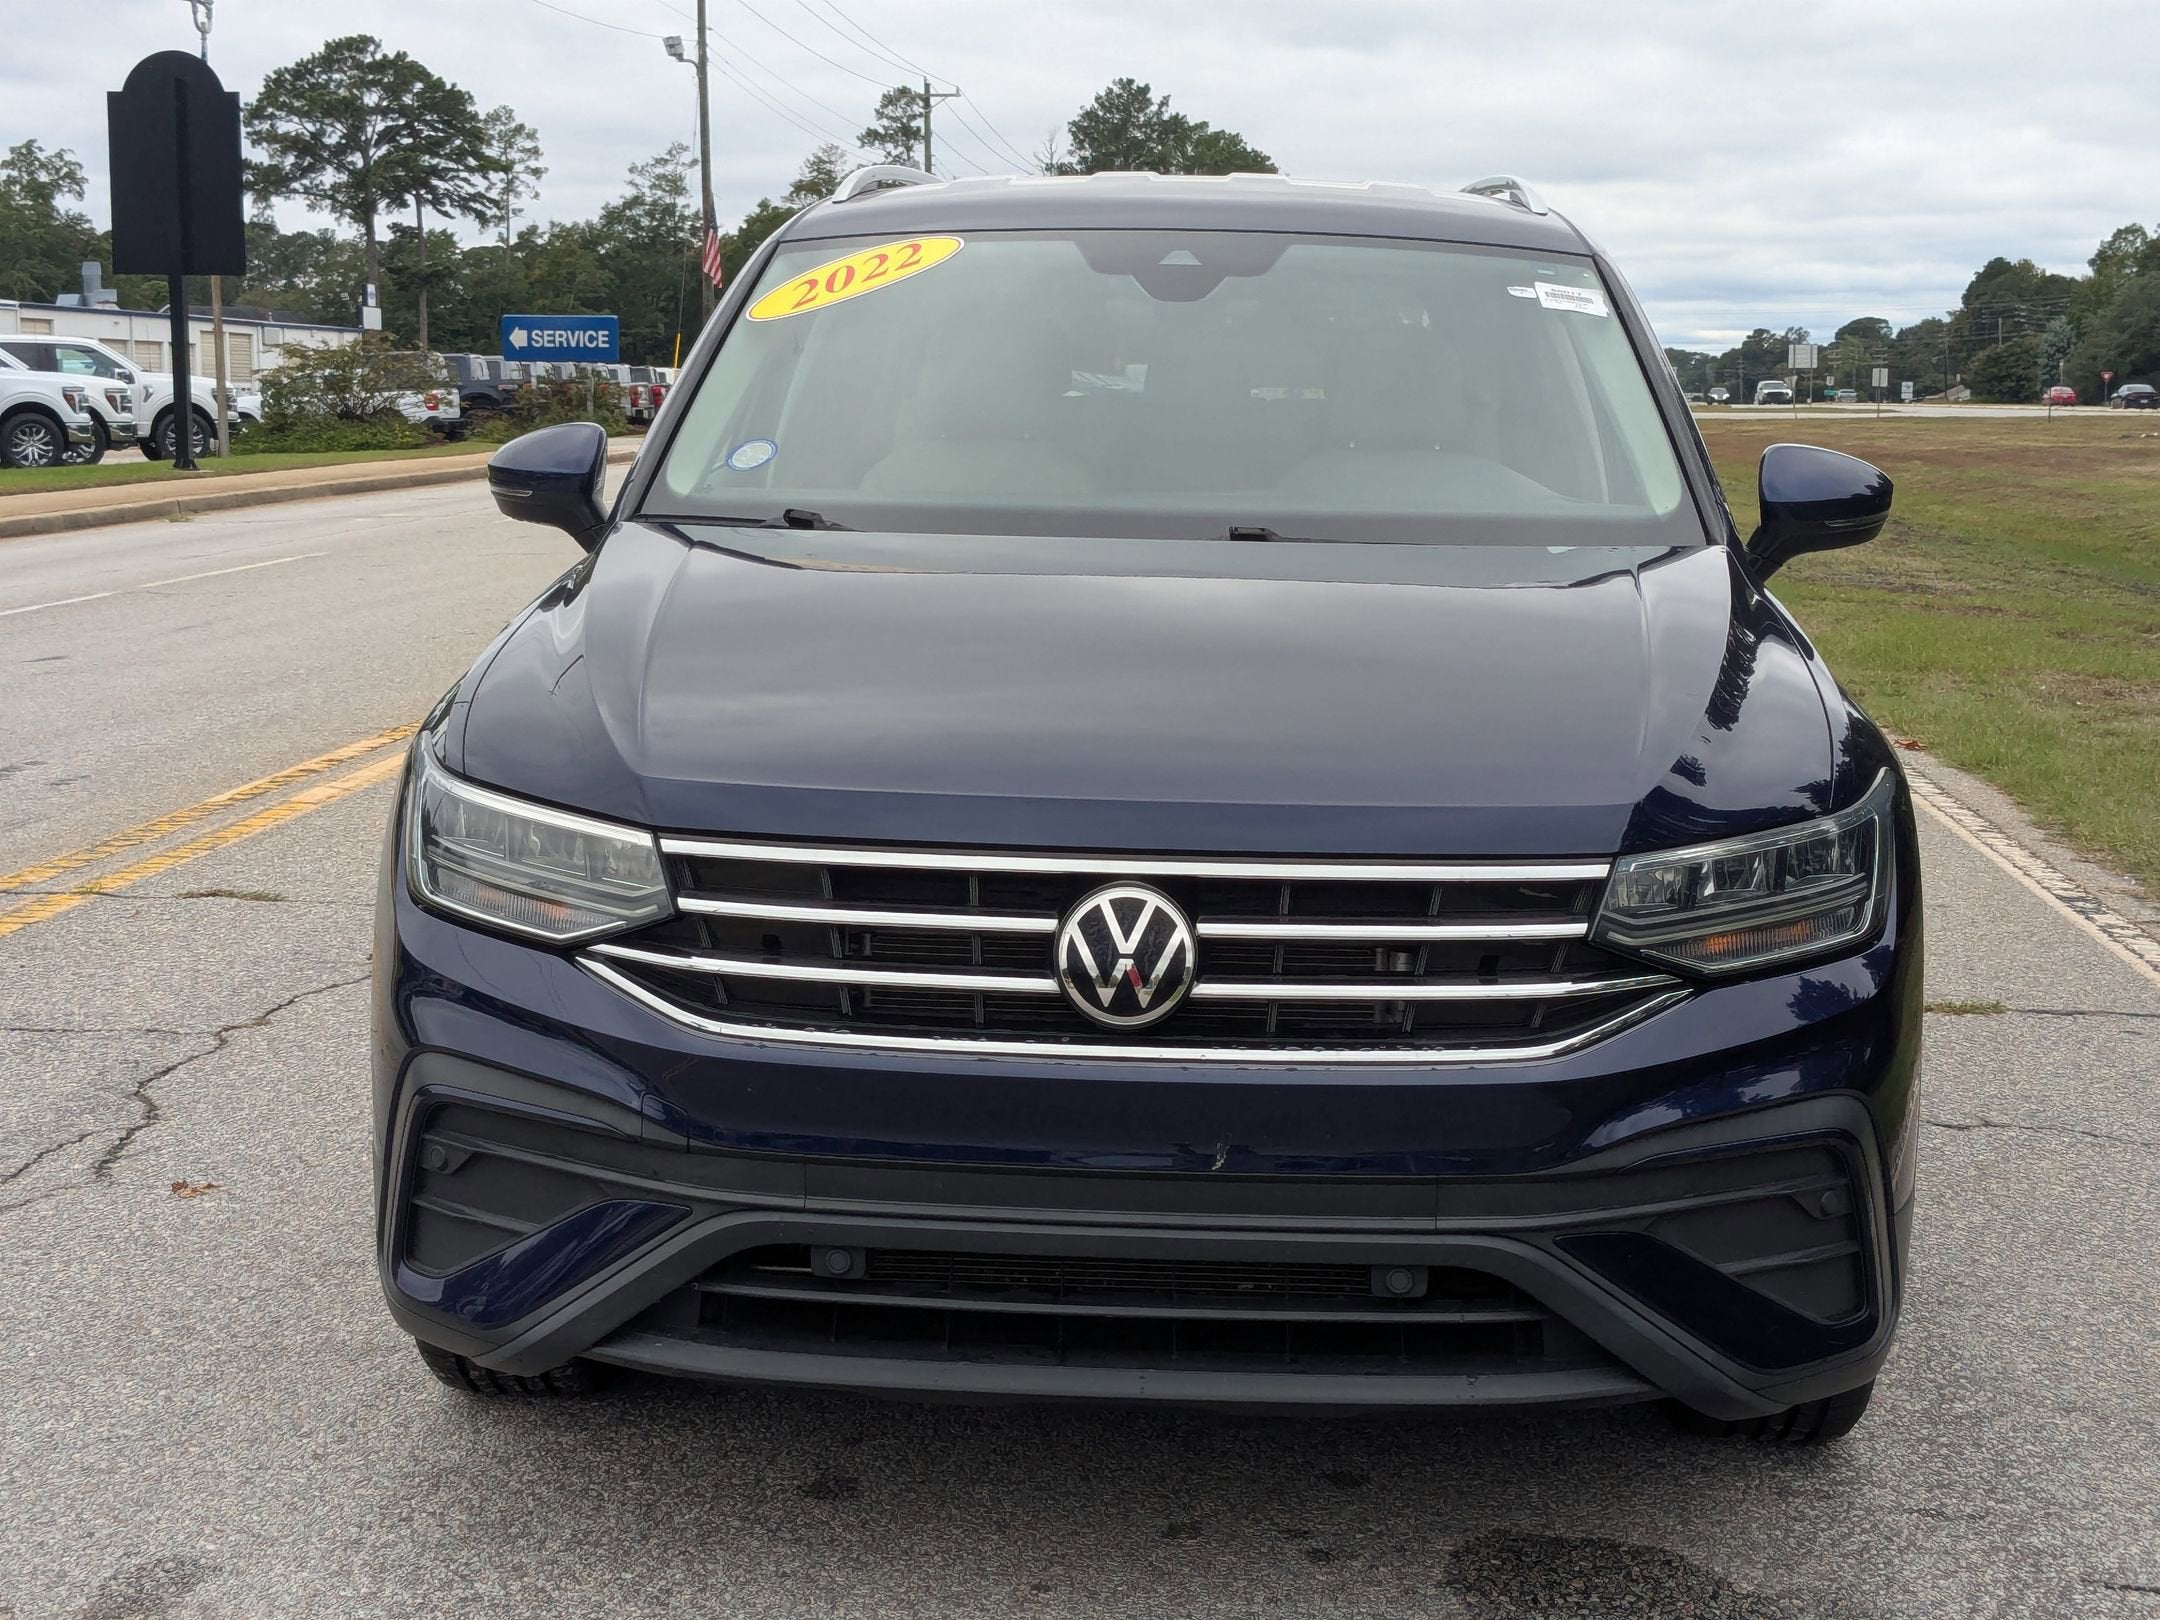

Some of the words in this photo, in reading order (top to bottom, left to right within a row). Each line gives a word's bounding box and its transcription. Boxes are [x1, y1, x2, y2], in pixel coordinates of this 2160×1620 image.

[791, 243, 923, 310] 2022
[531, 330, 609, 348] SERVICE
[1067, 894, 1185, 1009] VW
